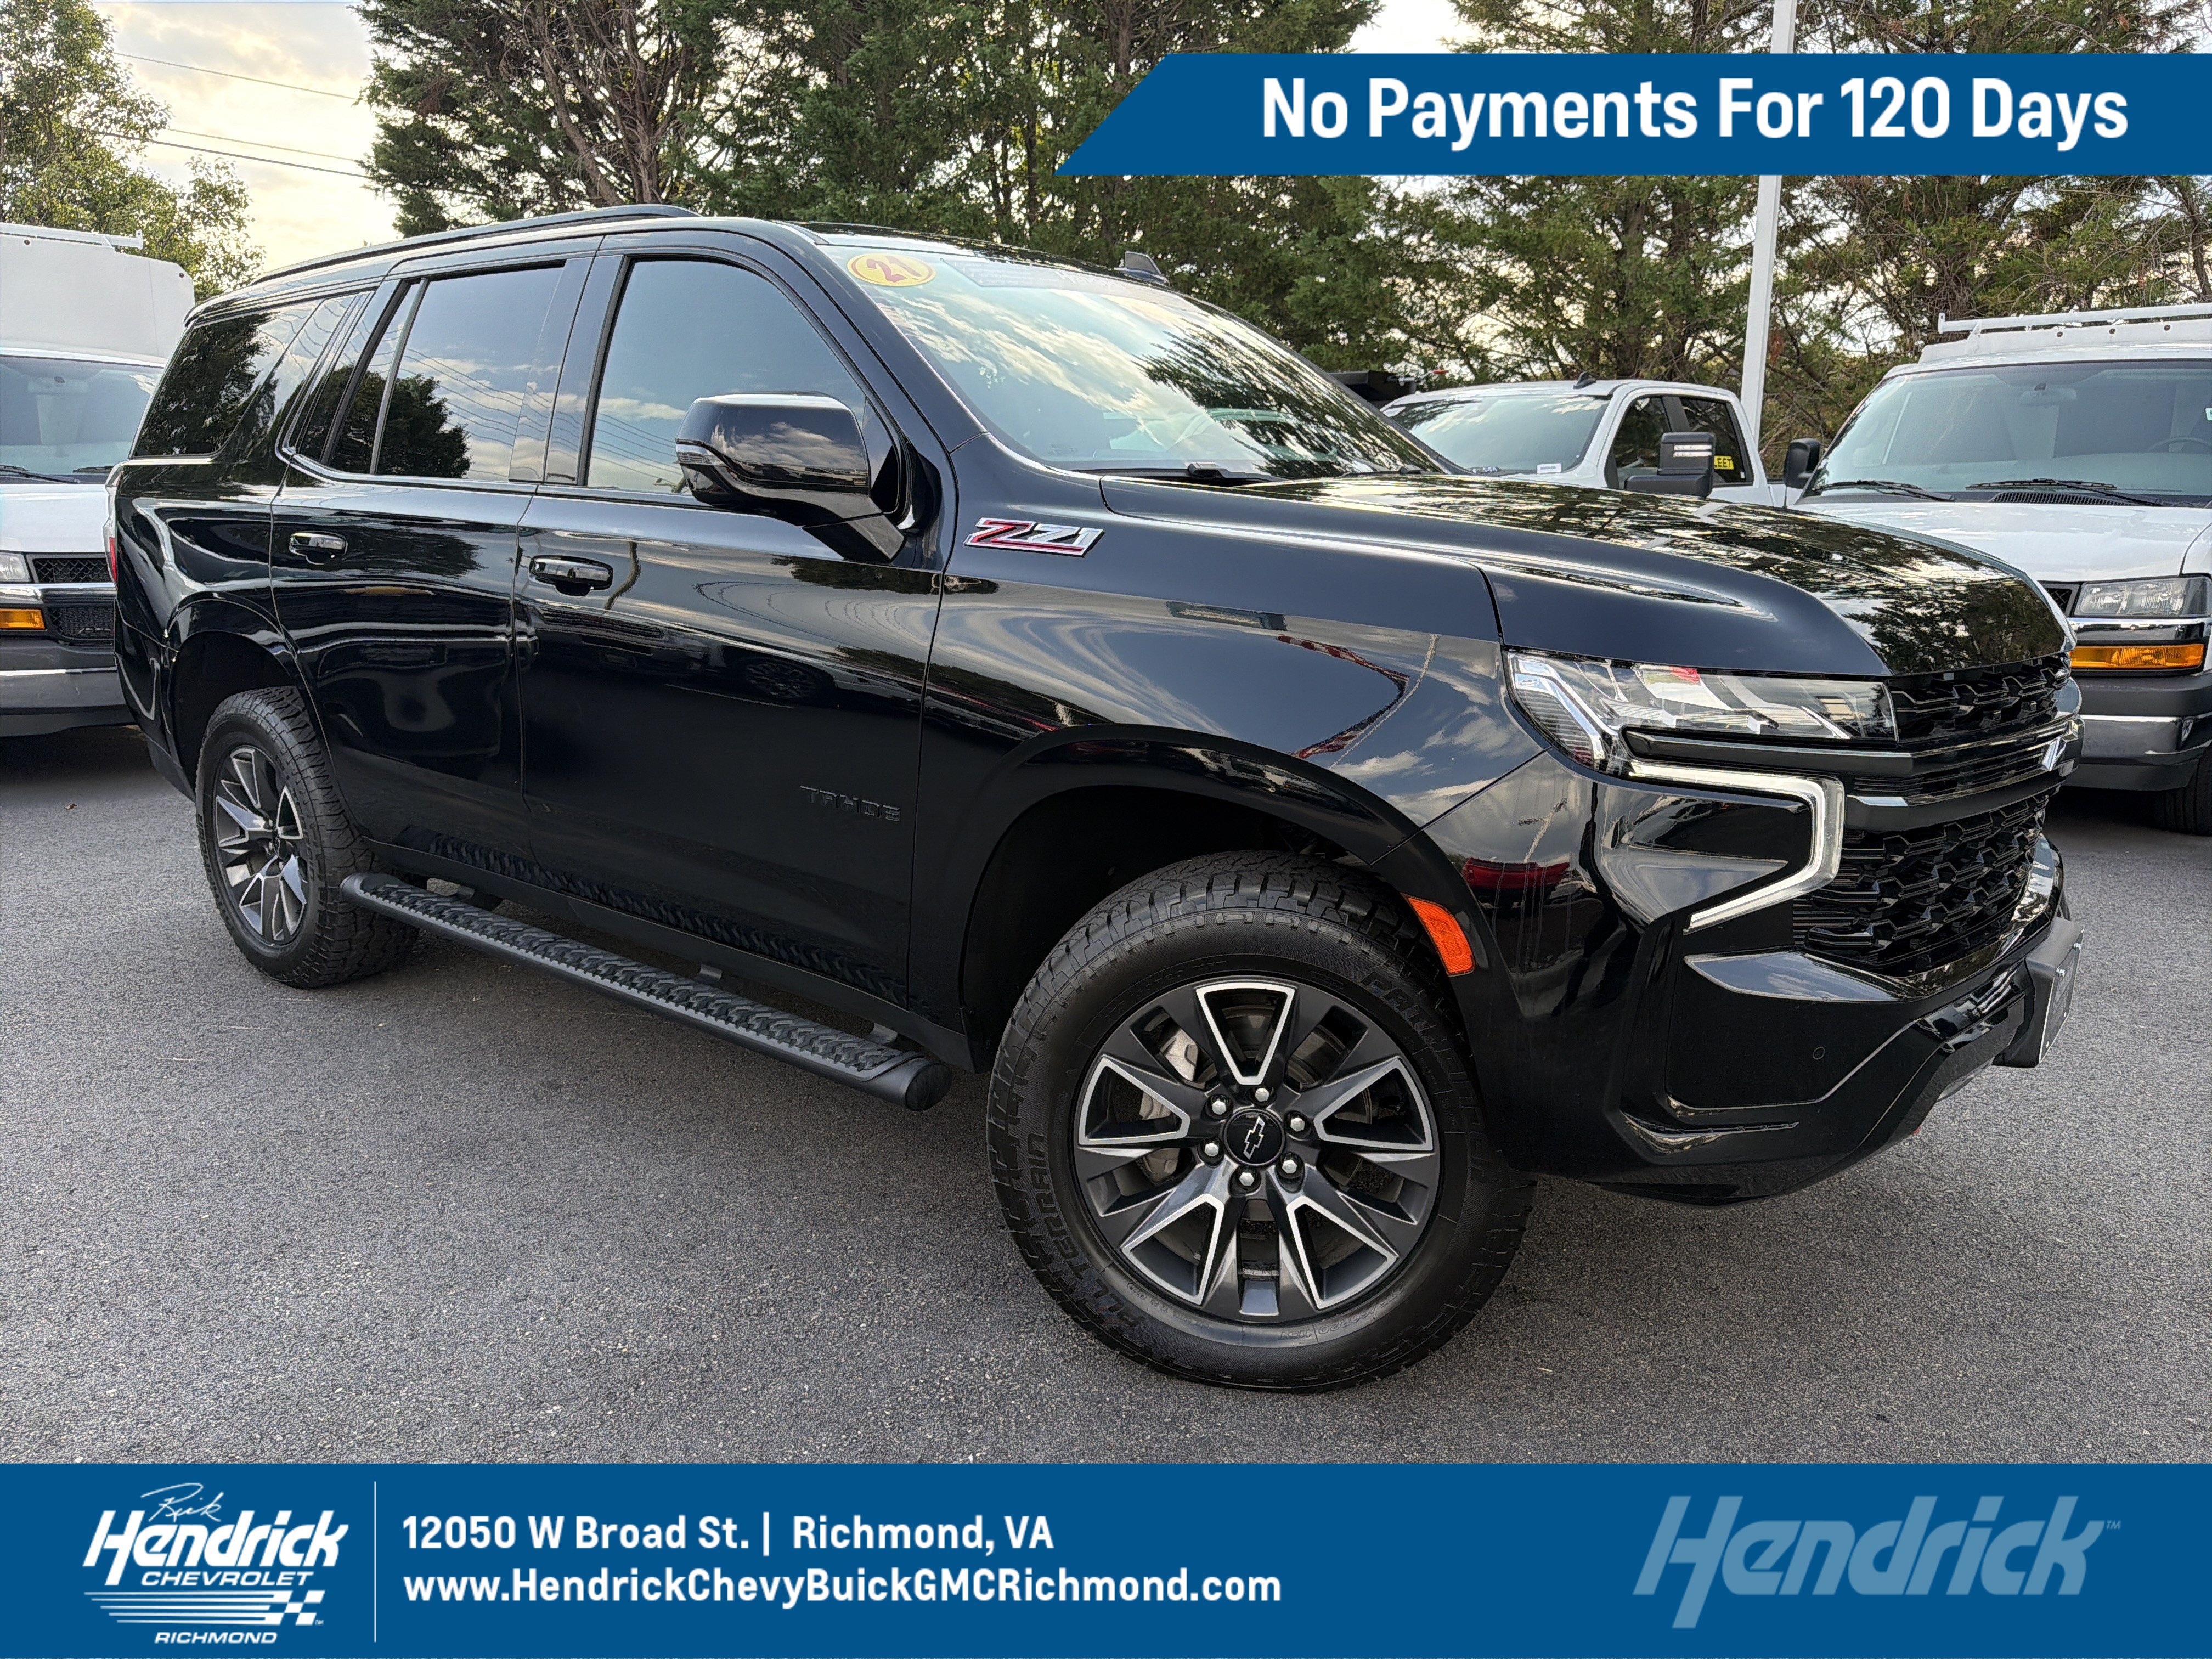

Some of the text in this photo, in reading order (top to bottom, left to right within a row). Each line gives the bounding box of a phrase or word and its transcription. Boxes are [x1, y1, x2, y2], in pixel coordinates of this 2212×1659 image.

[866, 255, 923, 283] 21
[1714, 458, 1731, 468] EET
[963, 517, 1105, 557] Z71
[800, 785, 900, 822] TAHOE
[1027, 1132, 1146, 1328] ALL TERRAIN
